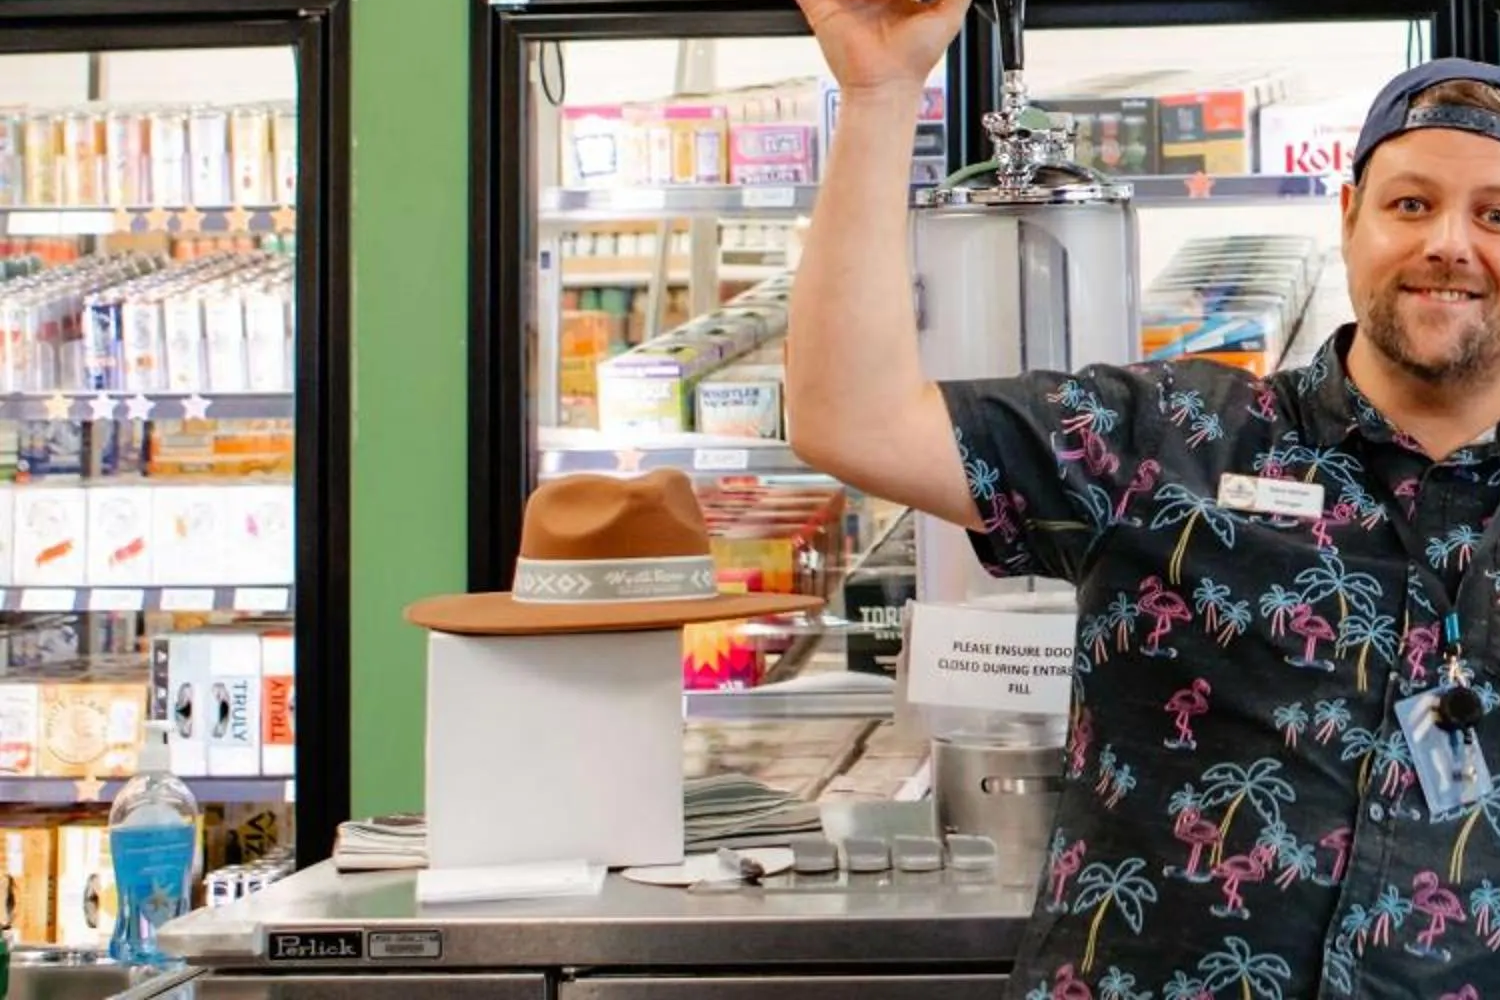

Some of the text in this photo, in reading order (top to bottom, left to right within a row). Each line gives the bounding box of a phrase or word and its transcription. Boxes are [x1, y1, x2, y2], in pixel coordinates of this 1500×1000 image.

[952, 641, 992, 653] PLEASE
[995, 643, 1041, 657] ENSURE
[938, 658, 979, 671] CLOSED
[983, 661, 1029, 676] DURING
[1008, 683, 1032, 695] FILL
[232, 680, 248, 742] TRULY
[270, 679, 286, 742] TRULY
[275, 934, 357, 957] Perlick
